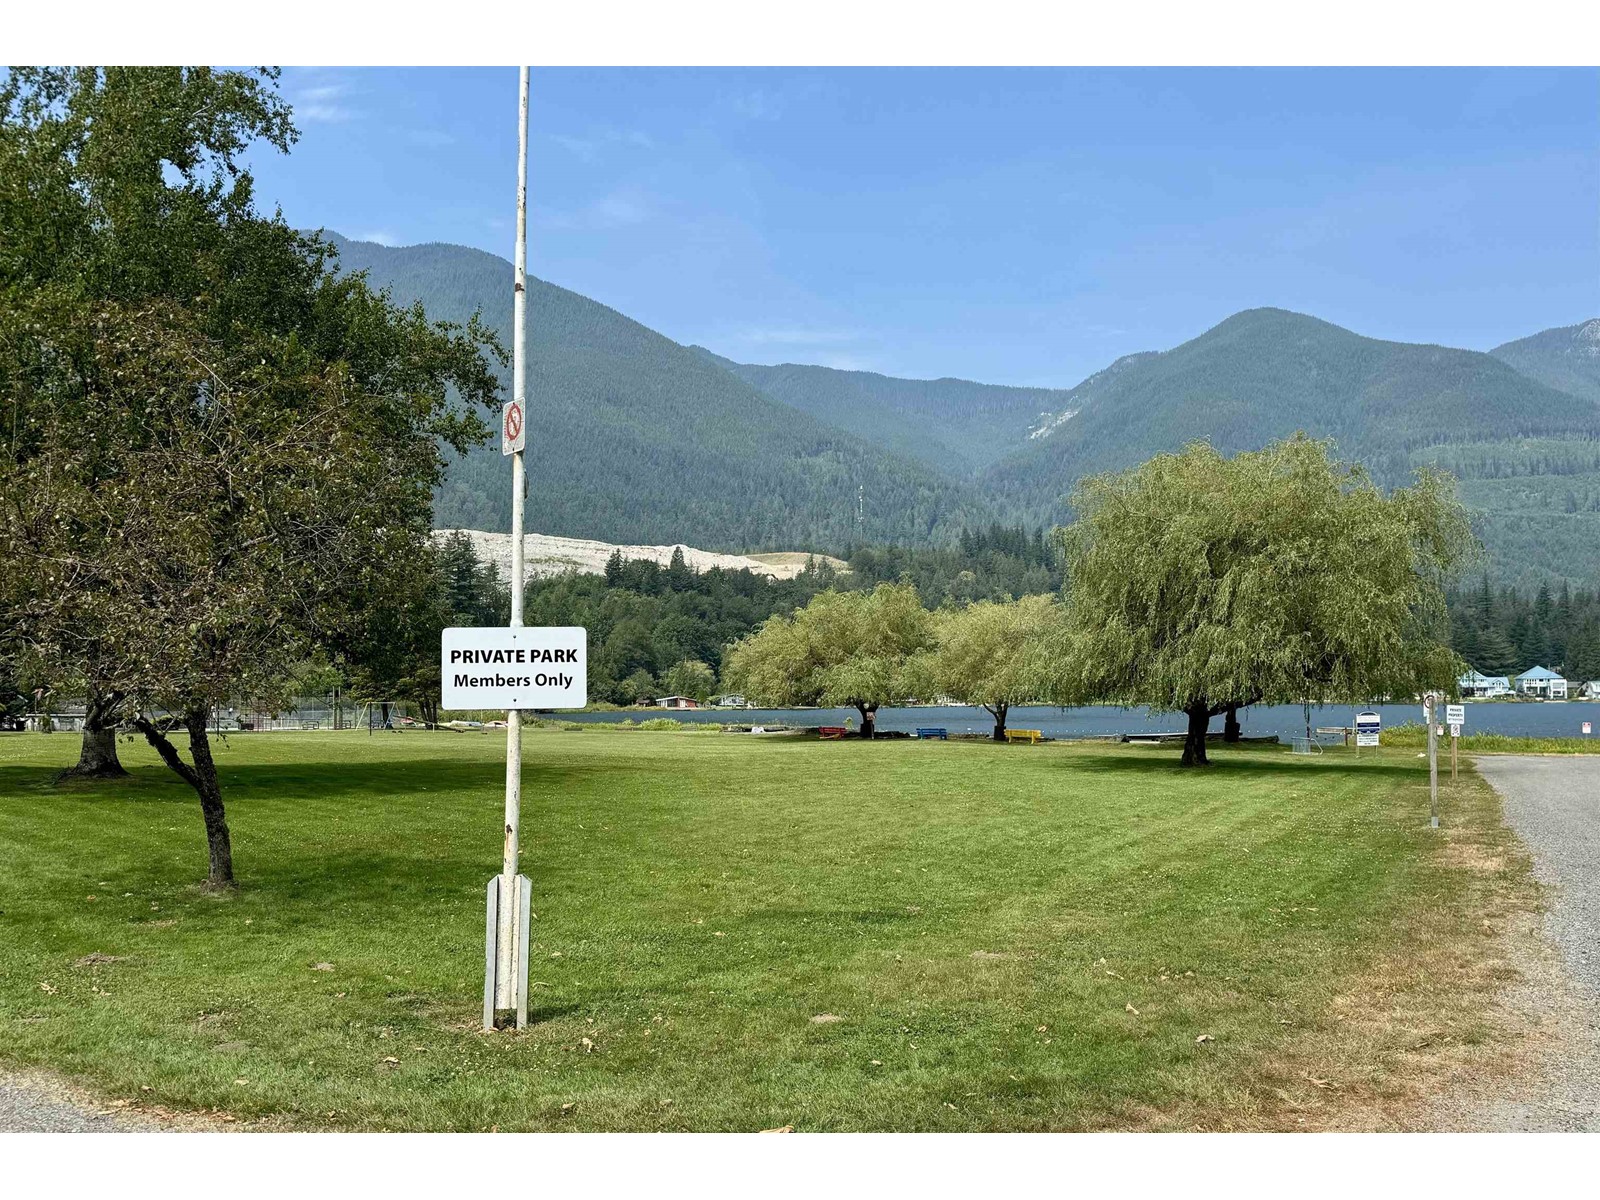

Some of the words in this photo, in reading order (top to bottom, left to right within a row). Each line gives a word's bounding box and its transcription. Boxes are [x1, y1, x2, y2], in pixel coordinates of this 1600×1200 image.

[450, 649, 526, 664] PRIVATE
[530, 648, 578, 663] PARK
[453, 673, 531, 687] Members
[535, 672, 573, 690] Only
